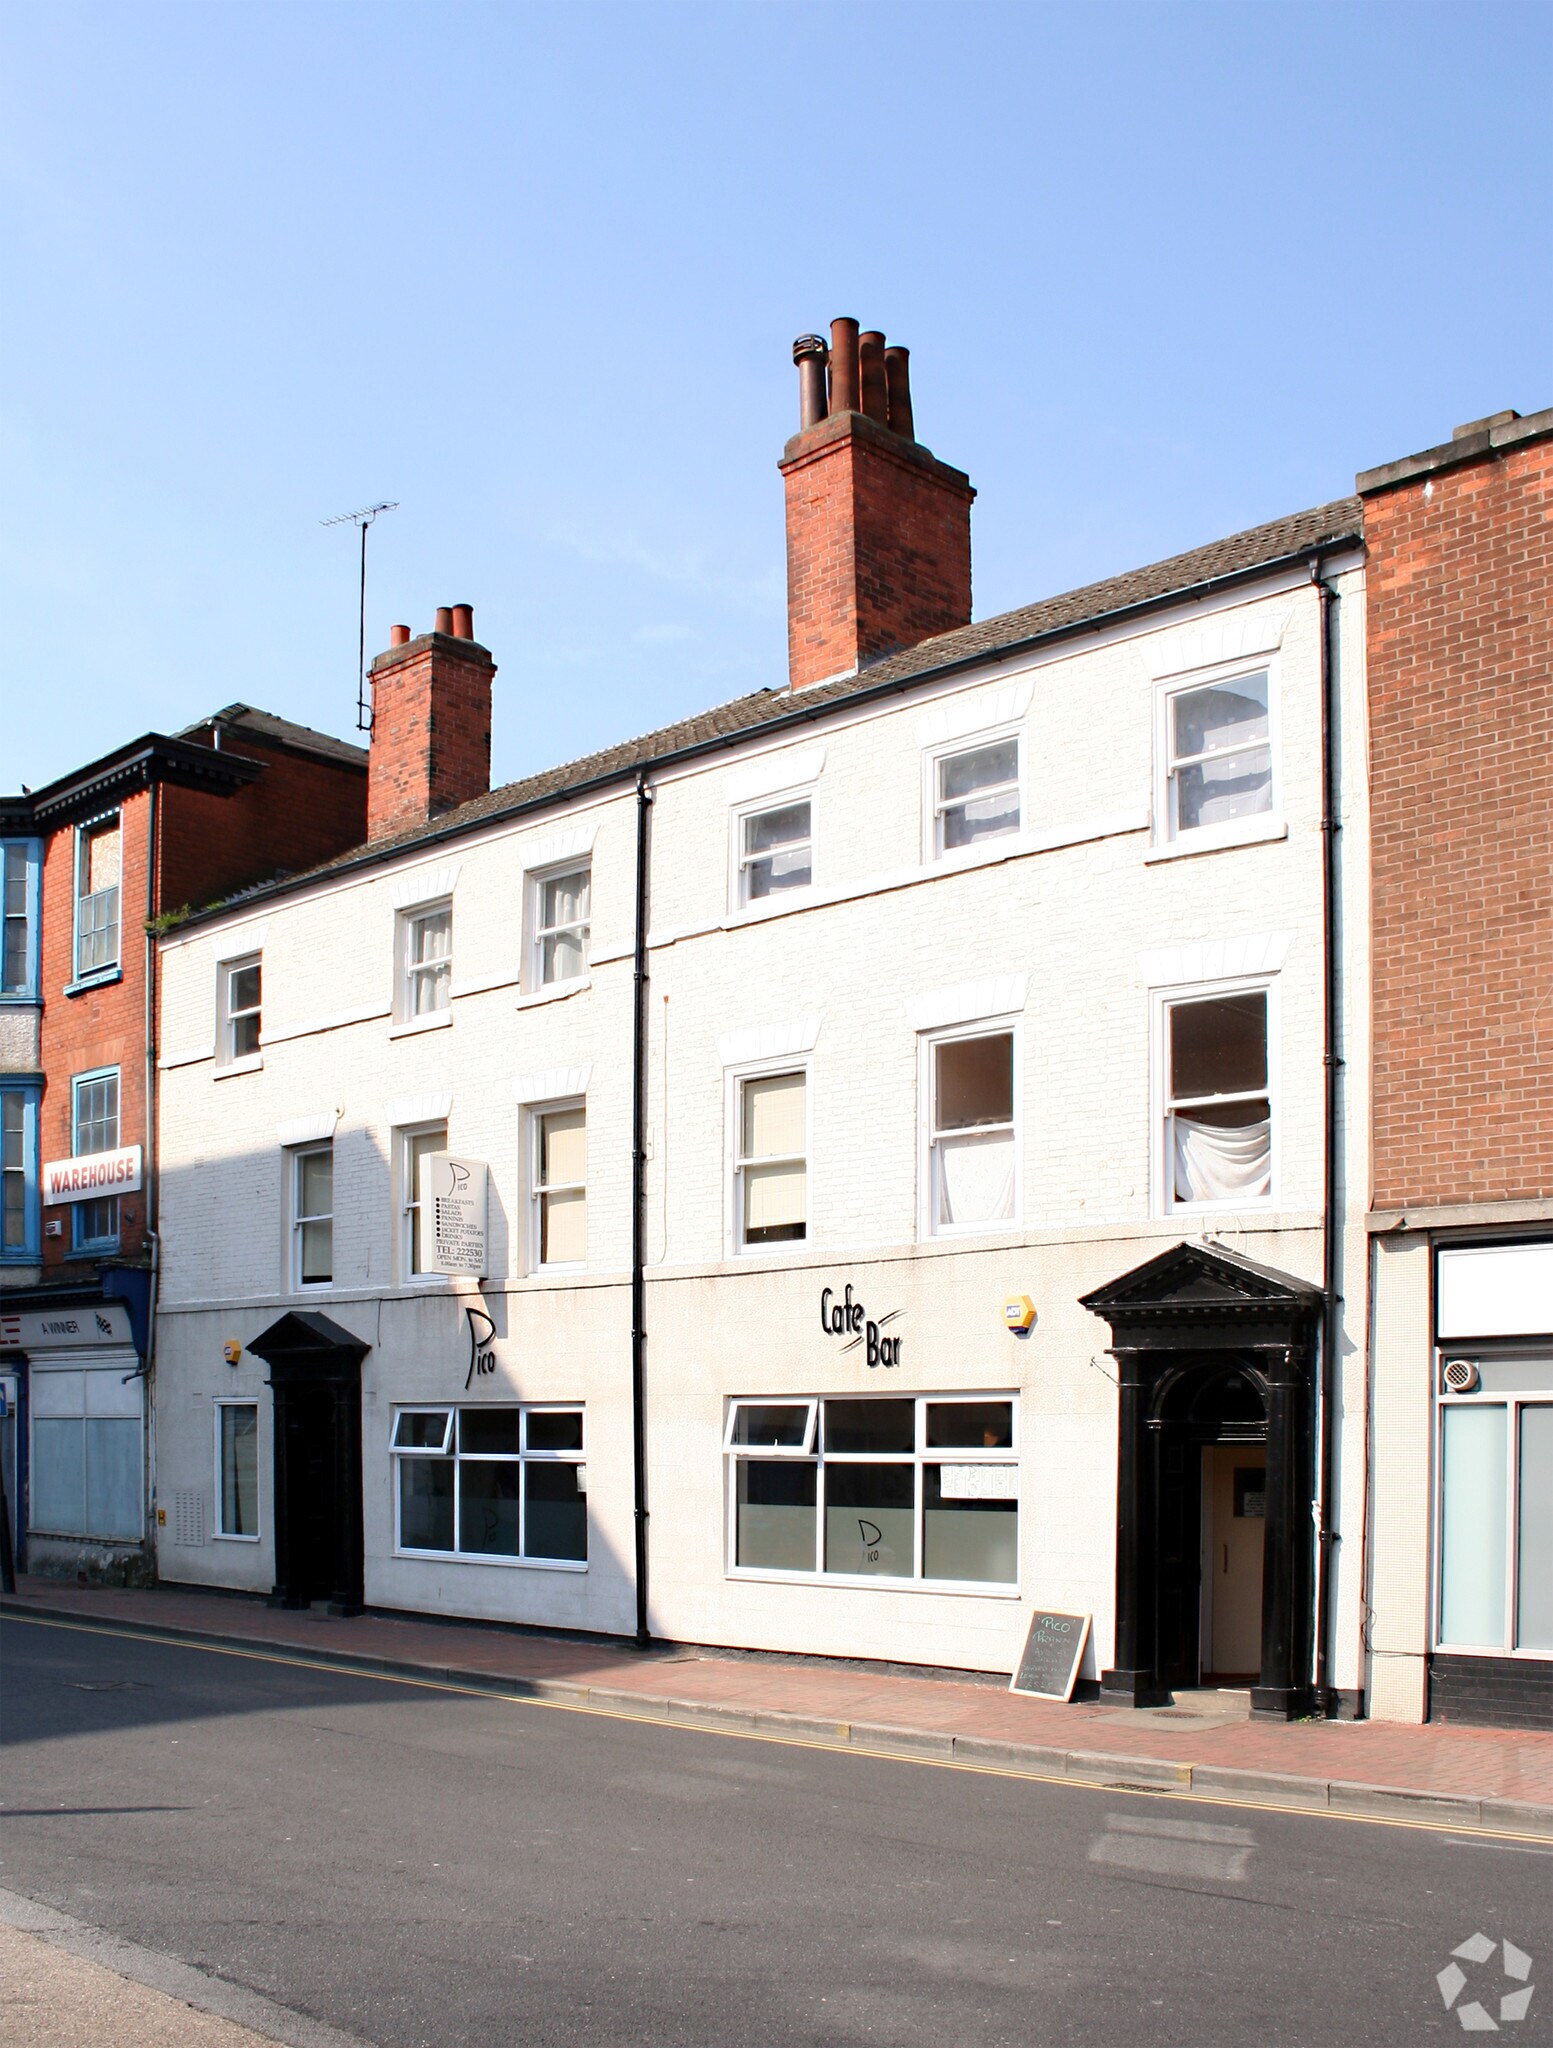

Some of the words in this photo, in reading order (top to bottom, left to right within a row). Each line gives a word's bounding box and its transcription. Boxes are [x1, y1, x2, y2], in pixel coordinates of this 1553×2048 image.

[50, 1157, 134, 1194] WAREHOUSE
[441, 1197, 475, 1206] BREAKFASTS
[441, 1221, 478, 1229] SANDWICHES
[442, 1232, 463, 1240] DRINKS
[460, 1229, 484, 1237] POTATOES
[461, 1241, 484, 1249] PARTIES
[456, 1247, 483, 1258] 222530
[41, 1322, 49, 1335] A
[48, 1320, 81, 1334] WINNER
[821, 1283, 865, 1334] Cafe
[866, 1320, 901, 1367] Bar
[464, 1307, 497, 1391] Pico
